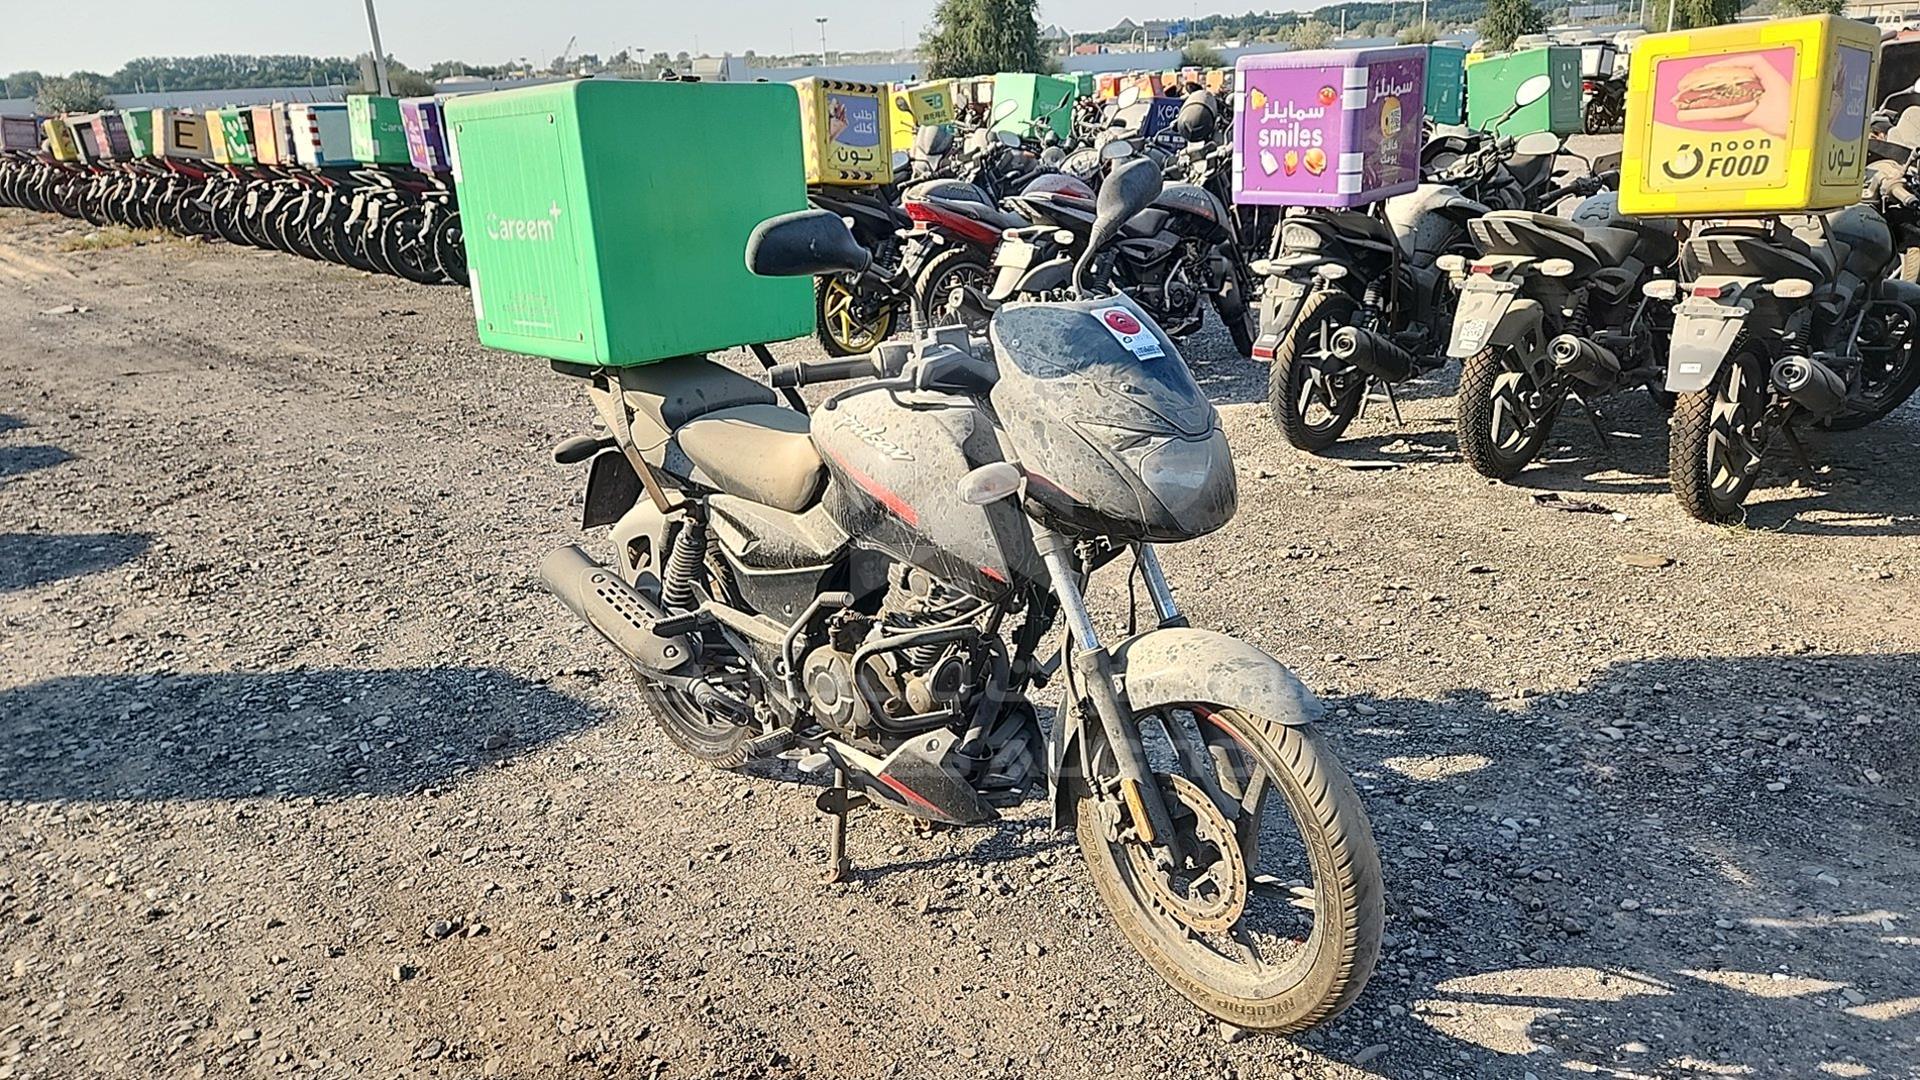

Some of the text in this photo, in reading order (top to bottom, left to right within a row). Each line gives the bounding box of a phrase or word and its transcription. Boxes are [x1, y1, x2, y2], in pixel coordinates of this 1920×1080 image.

[1260, 100, 1325, 124] سمايلز
[174, 119, 198, 149] E
[1258, 121, 1323, 148] smiles
[1710, 138, 1771, 152] noon
[837, 146, 873, 166] نون
[1705, 154, 1770, 178] FOOD
